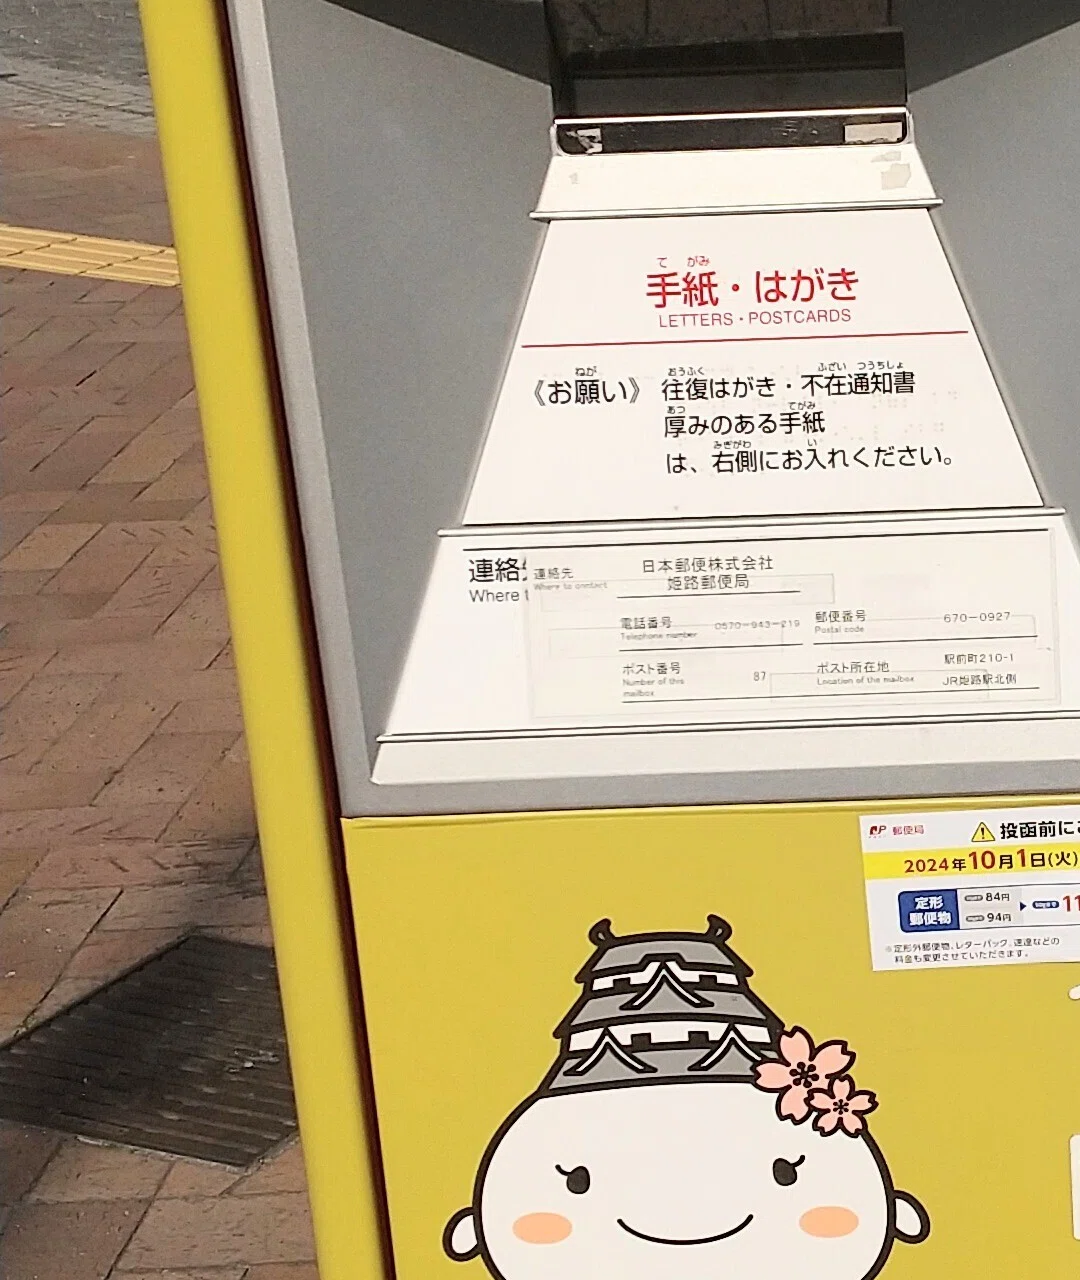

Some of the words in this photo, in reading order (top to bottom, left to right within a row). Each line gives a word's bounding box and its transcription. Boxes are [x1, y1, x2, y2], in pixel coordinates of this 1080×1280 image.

[656, 257, 668, 268] て
[687, 255, 711, 268] がみ
[646, 267, 859, 308] 手紙・はがき
[532, 377, 644, 407] 《お願い》
[661, 370, 916, 401] 往復はがき・不在通知書
[663, 410, 826, 438] 厚みのある手紙
[666, 445, 954, 474] は、右側にお入れください。
[642, 555, 774, 573] 日本郵便株式会社
[667, 573, 750, 591] 姫路郵便局
[469, 589, 520, 602] Where
[620, 616, 672, 630] 電話番号
[815, 609, 867, 623] 郵便番号
[814, 625, 842, 634] Postal
[844, 625, 865, 633] code
[622, 662, 681, 675] ポスト番号
[816, 661, 890, 674] ポスト所在地
[753, 671, 767, 682] 87
[914, 895, 944, 910] 定形
[985, 892, 1010, 902] 84円
[908, 912, 952, 926] 郵便物
[986, 913, 1012, 923] 94円
